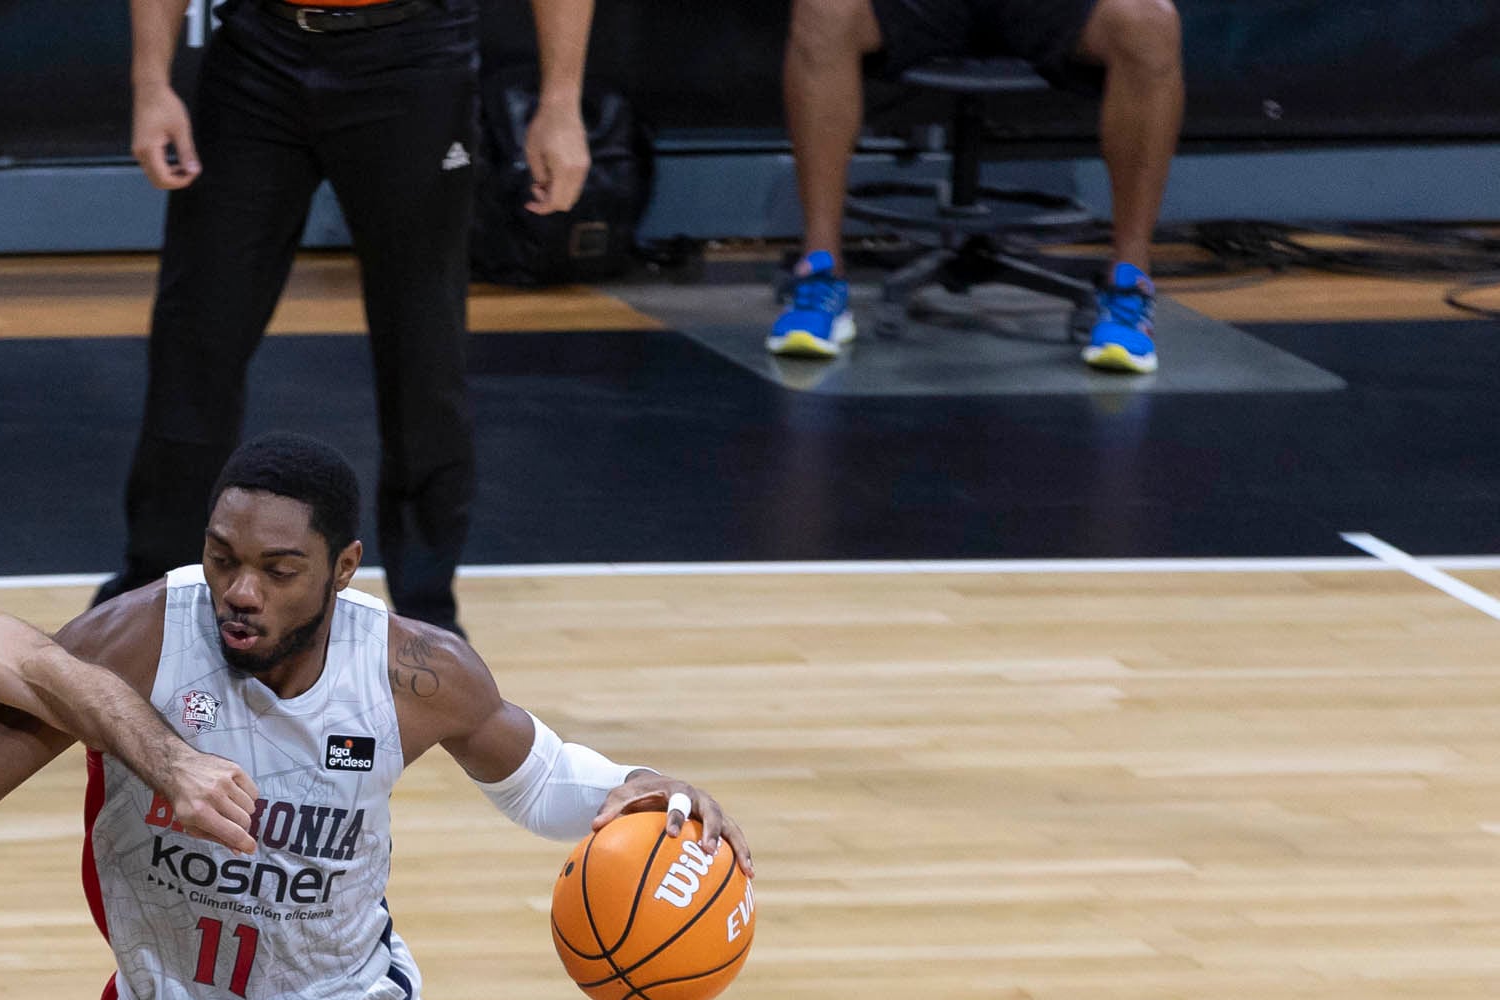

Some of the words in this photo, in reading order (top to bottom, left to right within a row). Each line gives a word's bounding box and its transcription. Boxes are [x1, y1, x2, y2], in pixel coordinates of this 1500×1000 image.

[329, 756, 371, 768] endesa
[330, 745, 350, 757] liga
[145, 792, 364, 860] BONIA
[654, 837, 722, 908] Wil
[189, 890, 281, 921] Climatización
[285, 908, 334, 921] eficiente
[193, 916, 259, 999] 11
